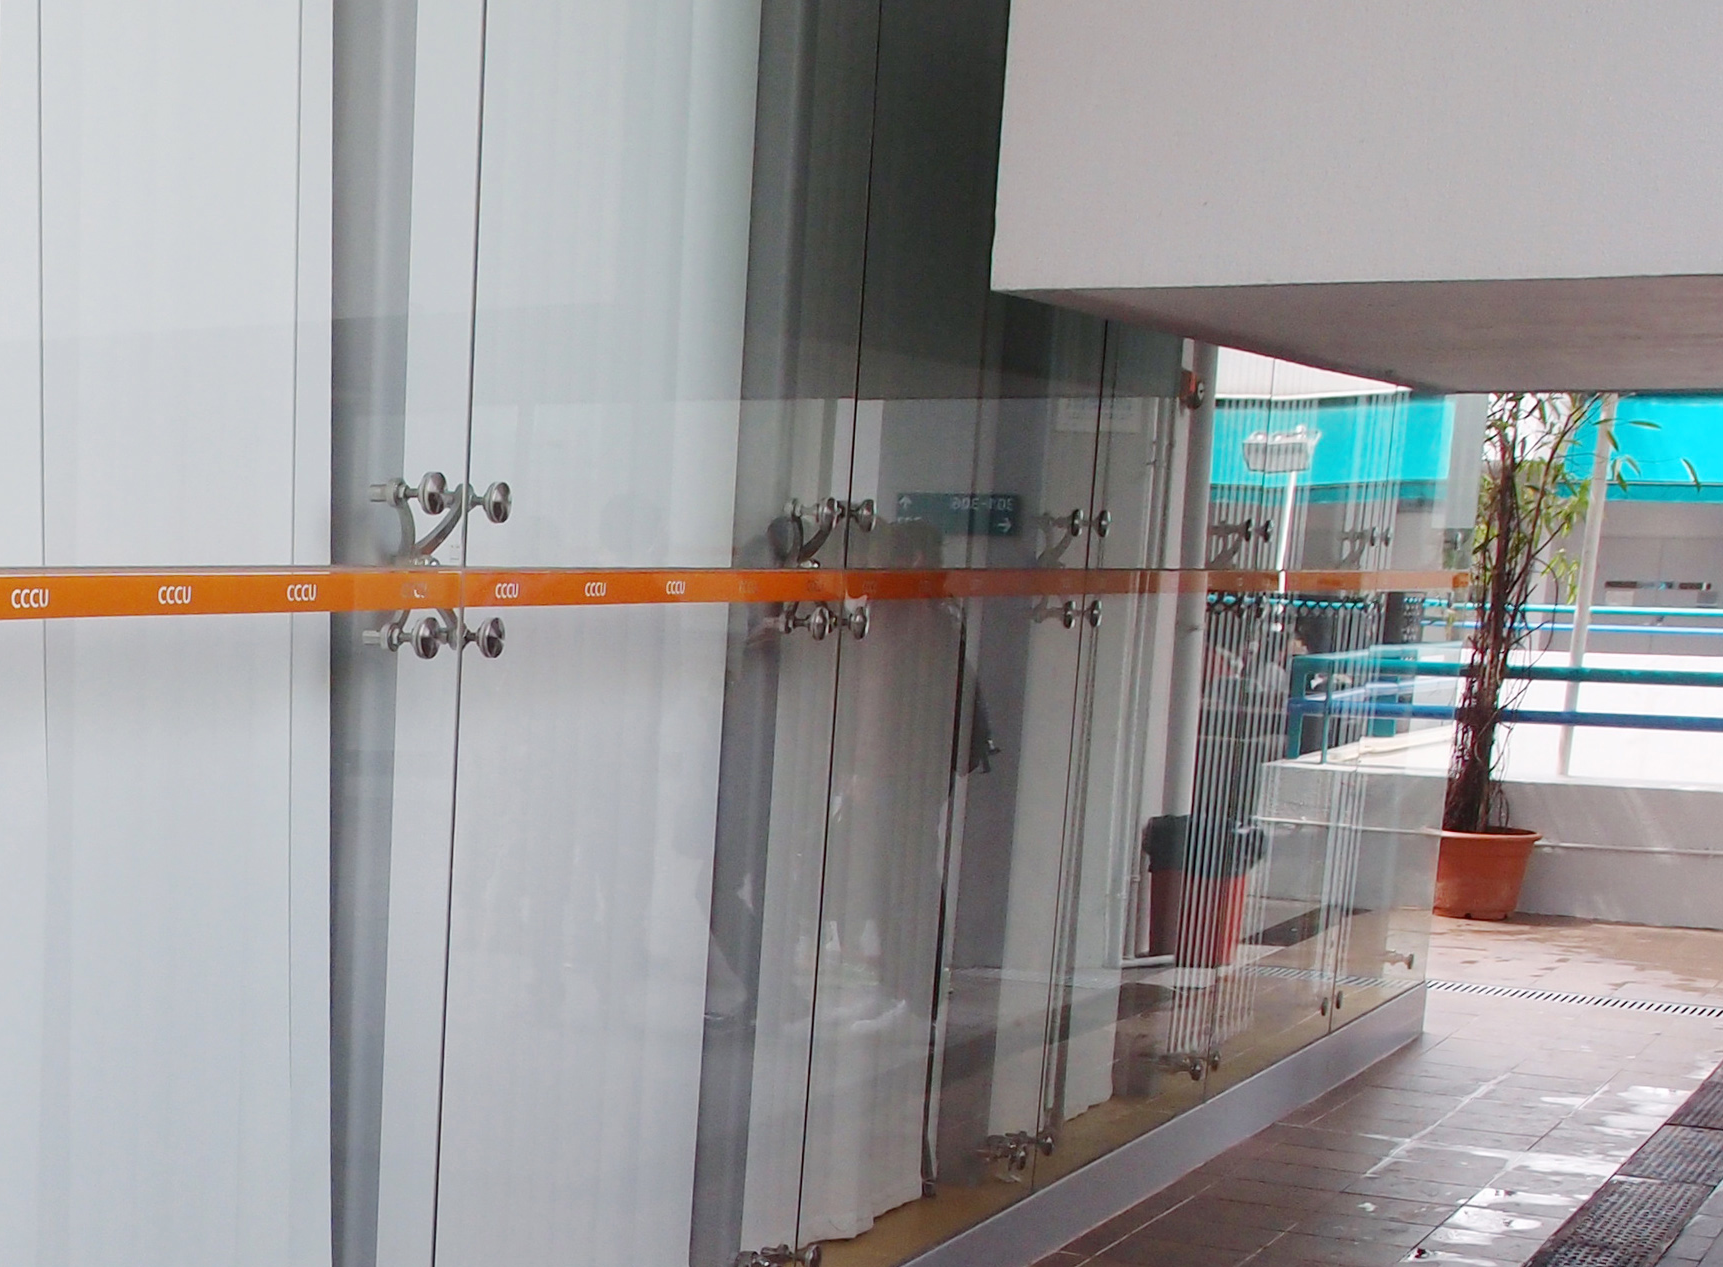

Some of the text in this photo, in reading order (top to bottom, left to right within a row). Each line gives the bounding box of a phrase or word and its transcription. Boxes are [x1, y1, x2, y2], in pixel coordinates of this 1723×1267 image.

[158, 585, 192, 605] CCCU
[287, 584, 317, 602] CCCU
[494, 583, 519, 599] CCCU
[585, 581, 607, 598] CCCU
[666, 580, 686, 596] CCCU
[11, 588, 50, 609] CCCU
